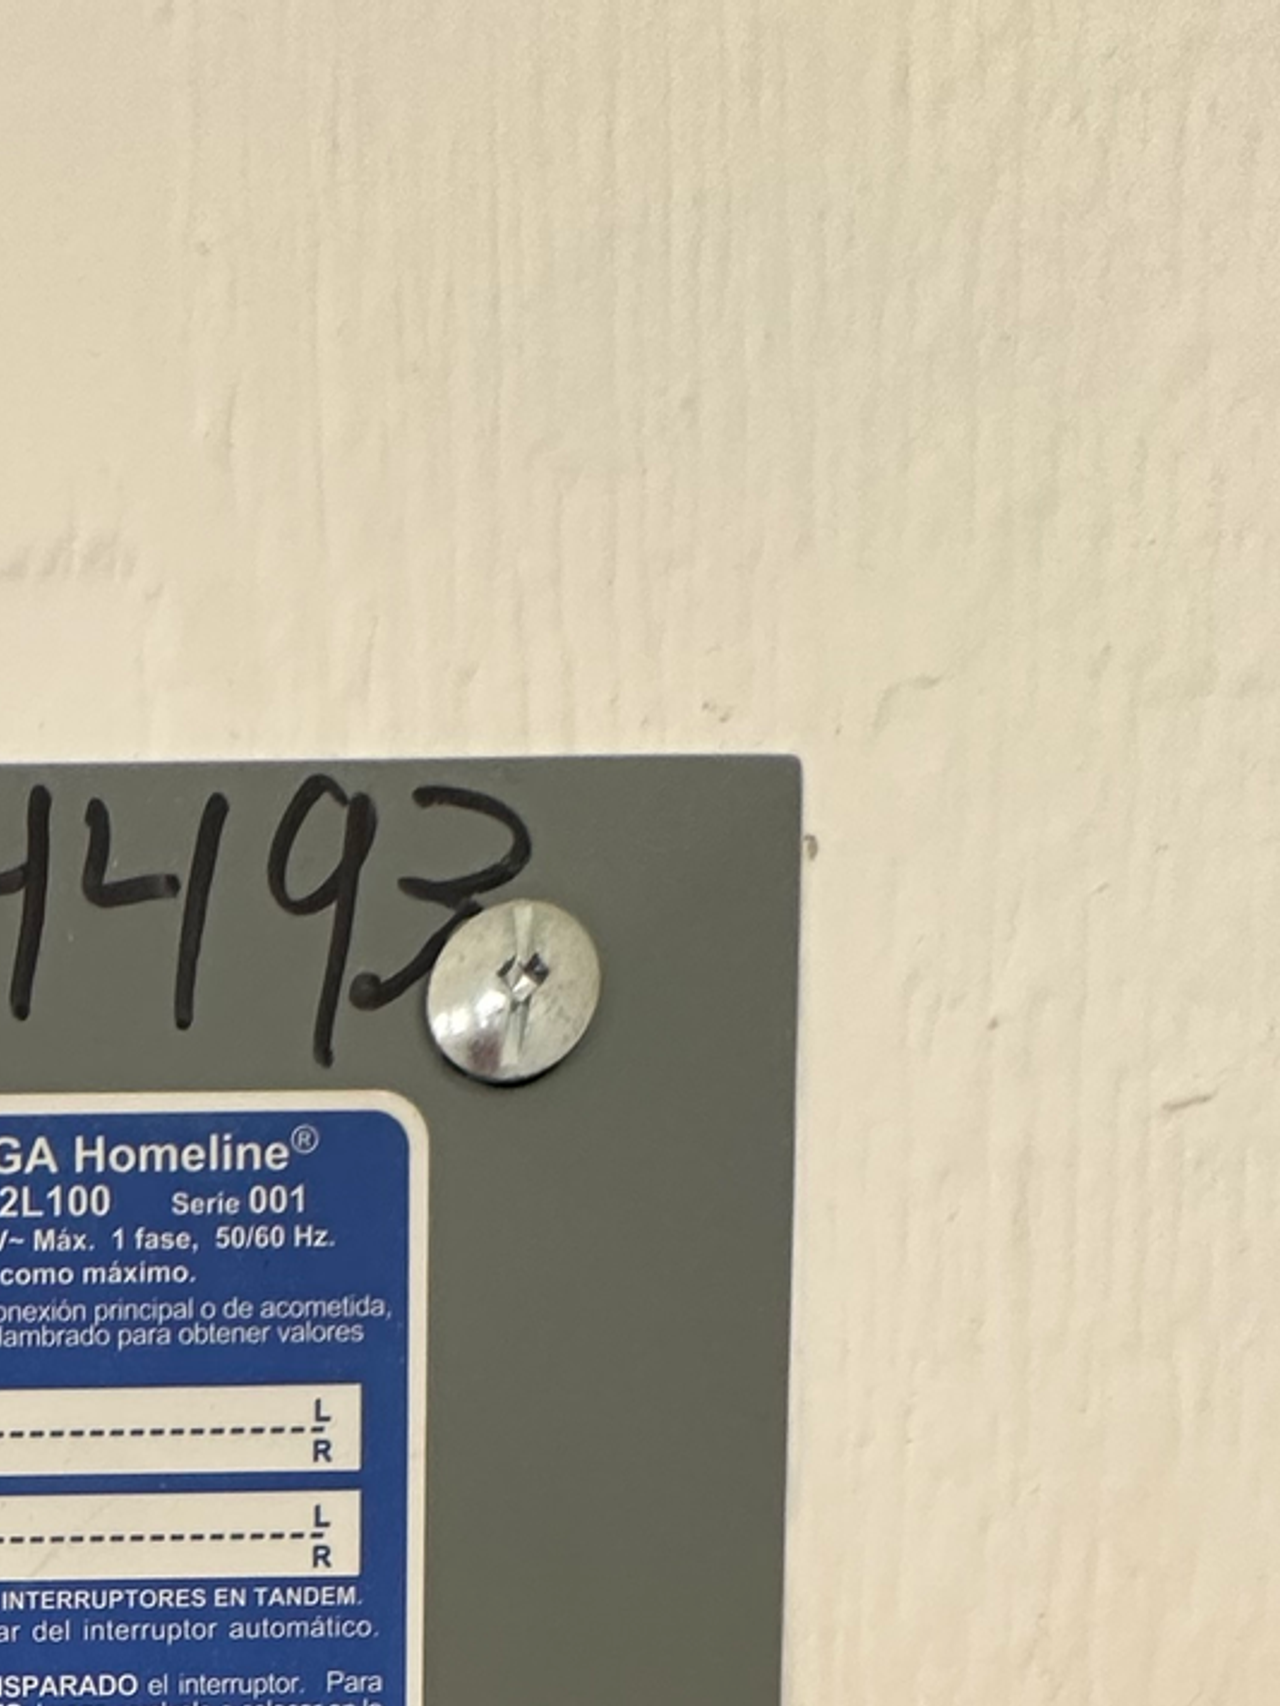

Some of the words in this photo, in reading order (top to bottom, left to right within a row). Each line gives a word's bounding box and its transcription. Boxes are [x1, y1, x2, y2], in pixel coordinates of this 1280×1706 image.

[171, 1191, 240, 1216] Serie
[249, 1184, 304, 1214] 001
[33, 1228, 95, 1252] Máx.
[112, 1227, 123, 1250] 1
[134, 1226, 199, 1253] fase,
[216, 1224, 285, 1249] 50/60
[294, 1224, 335, 1247] Hz.
[0, 1267, 74, 1286] como
[82, 1260, 196, 1284] máximo.
[315, 1398, 331, 1423] L
[313, 1439, 332, 1463] R
[314, 1504, 331, 1528] L
[312, 1545, 331, 1568] R
